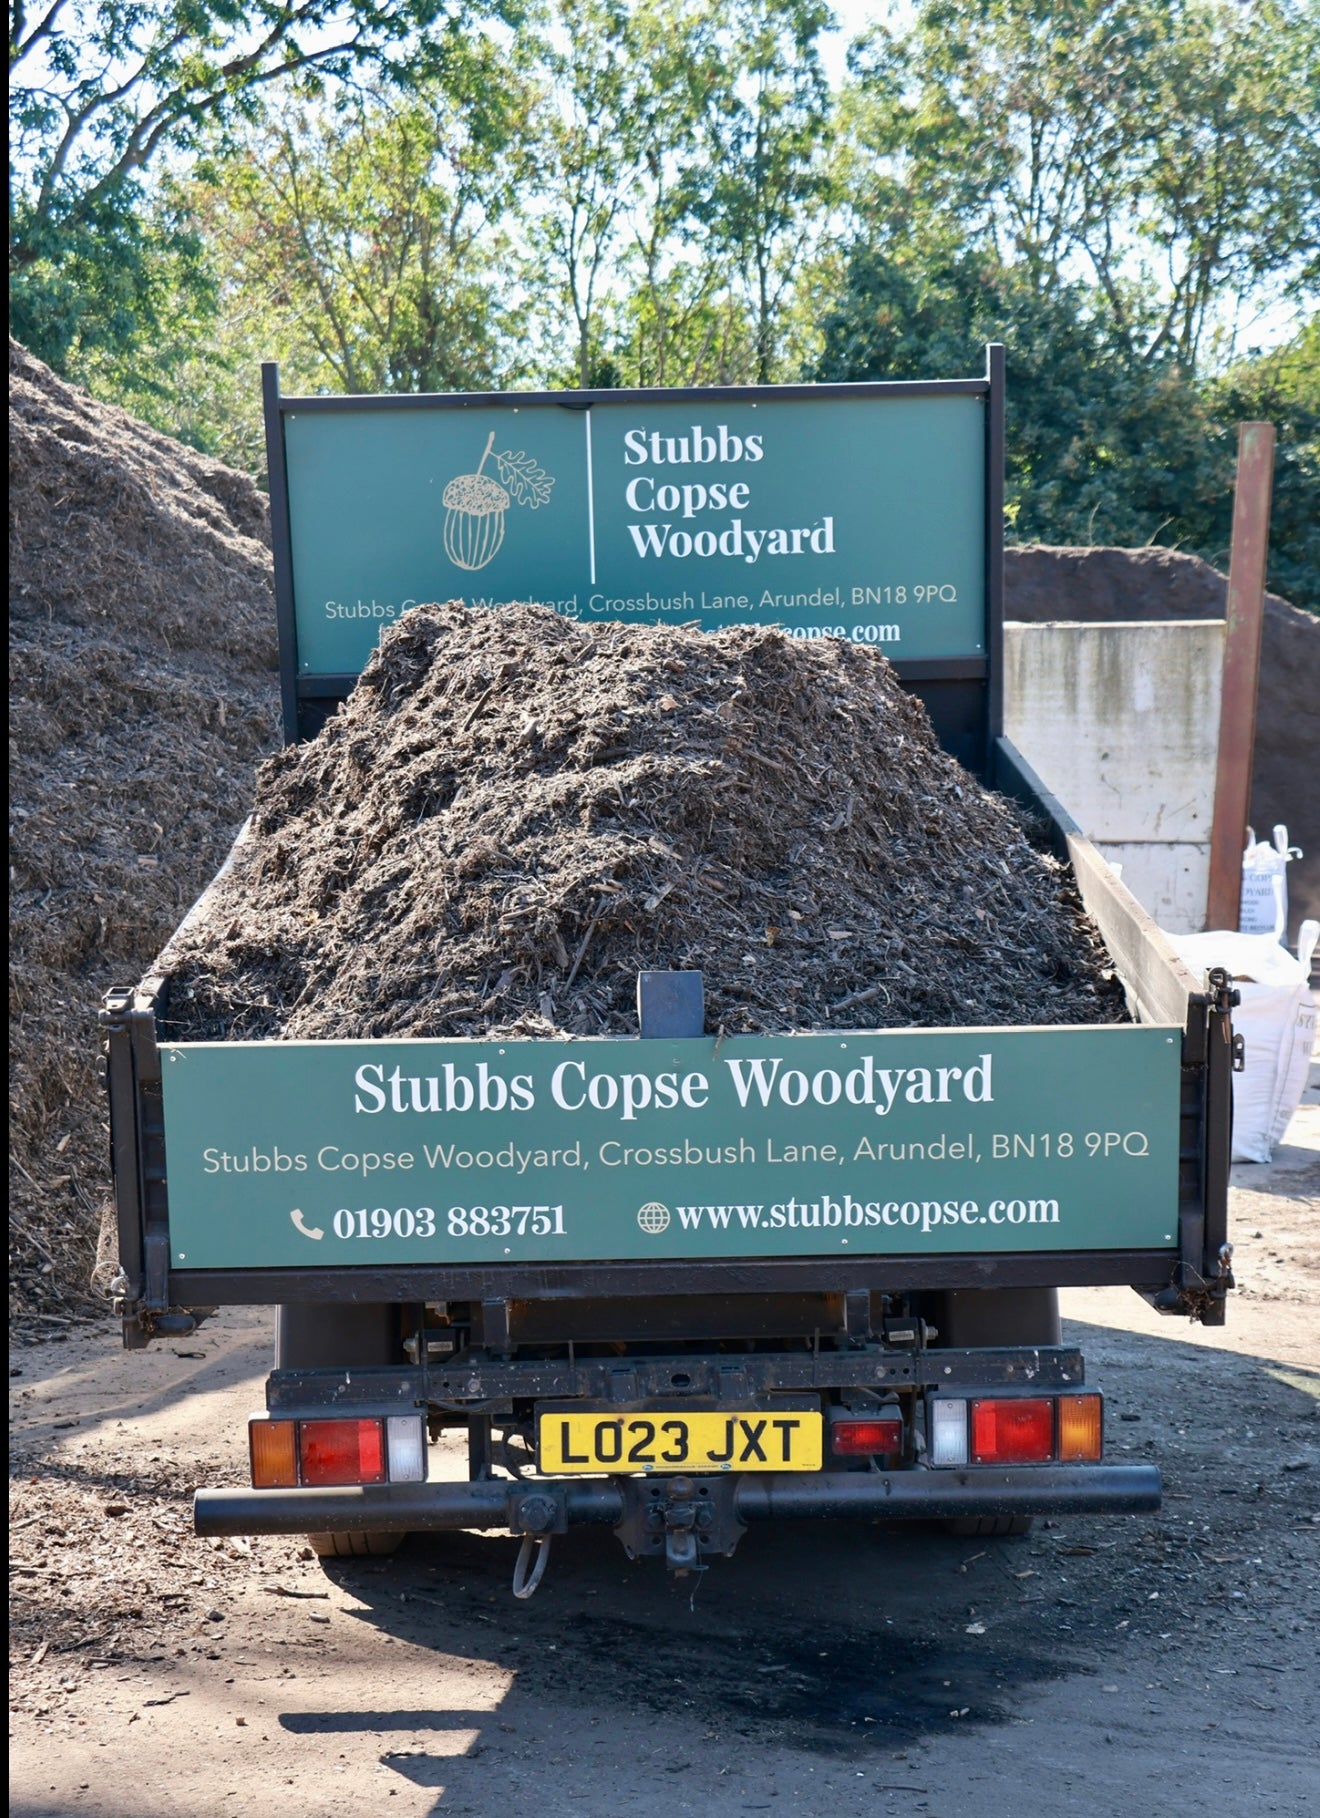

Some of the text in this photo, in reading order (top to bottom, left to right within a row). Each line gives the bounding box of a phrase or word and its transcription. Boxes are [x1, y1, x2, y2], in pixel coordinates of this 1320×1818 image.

[624, 425, 764, 465] Stubbs
[625, 477, 750, 518] Copse
[628, 516, 836, 564] Woodyard
[325, 599, 396, 619] Stubbs
[588, 591, 695, 613] Crossbush
[701, 591, 754, 611] Lane,
[759, 586, 846, 608] Arundel,
[851, 585, 907, 606] BN18
[913, 584, 957, 603] 9PQ
[354, 1053, 995, 1121] Stubbs Copse Woodyard
[203, 1130, 1150, 1178] Stubbs Copse Woodyard, Crossbush Lane, Arundel, BN18 9PQ
[333, 1194, 1061, 1239] 01903 883751 www.stubbscopse.com
[561, 1419, 800, 1464] LO23 JXT
